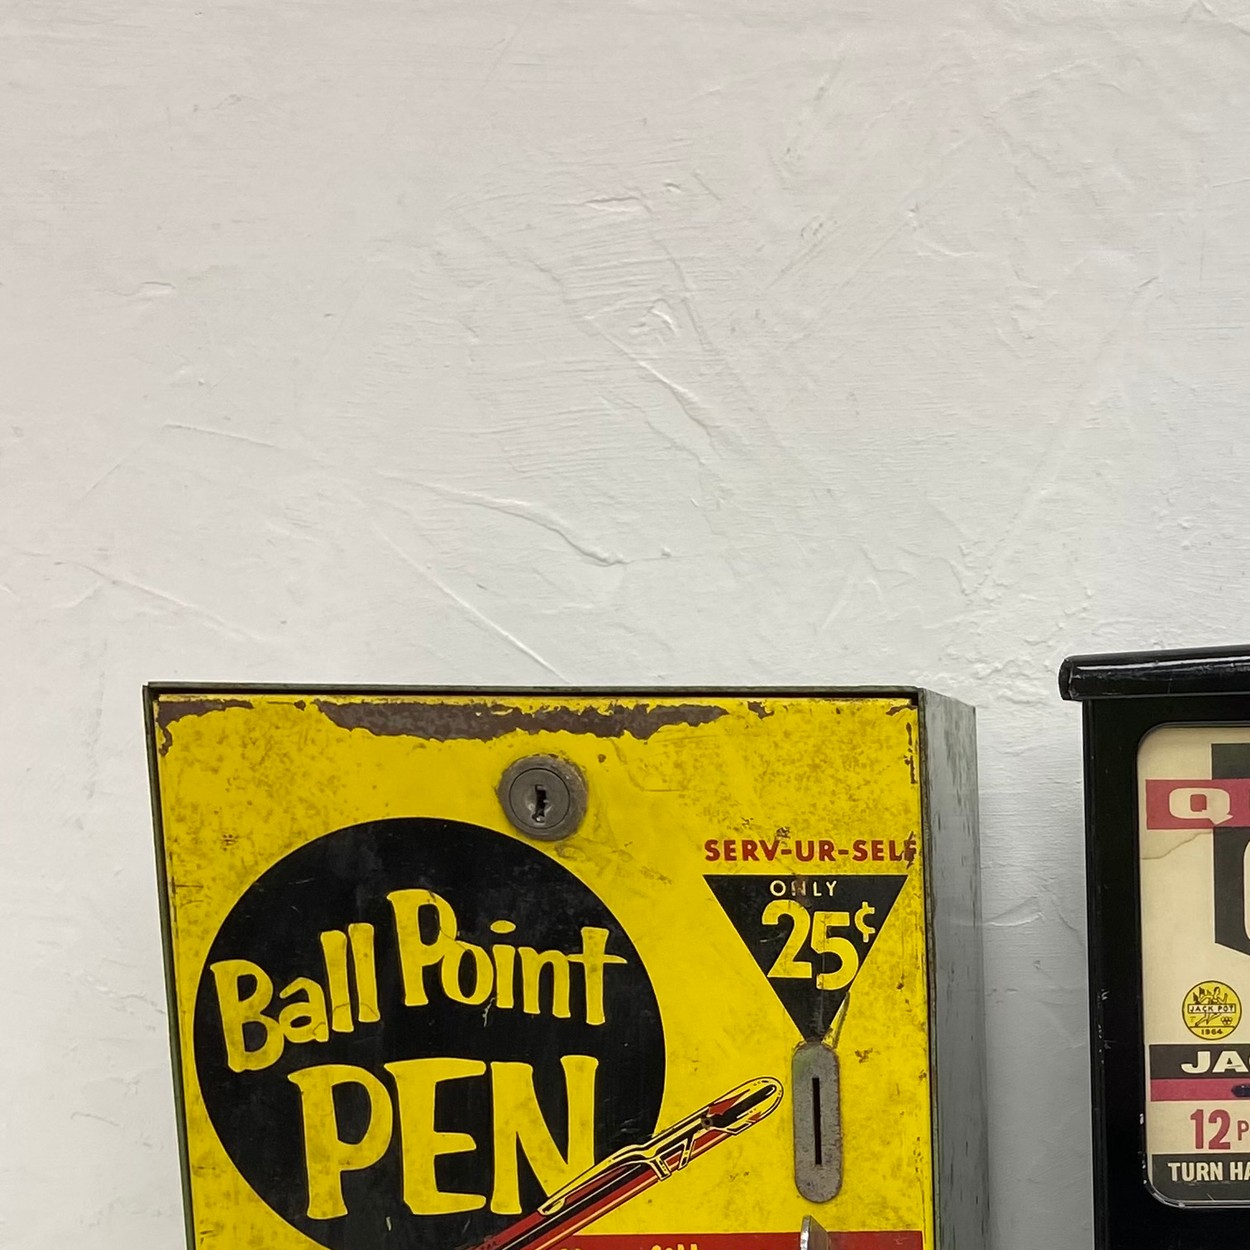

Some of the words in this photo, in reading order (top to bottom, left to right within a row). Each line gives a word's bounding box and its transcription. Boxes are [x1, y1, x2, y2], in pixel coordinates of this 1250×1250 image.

[769, 879, 838, 897] ONLY
[209, 922, 381, 1073] Ball
[387, 887, 629, 1026] Point
[1201, 1028, 1223, 1036] 1964
[287, 1054, 600, 1220] PEN
[1190, 1108, 1231, 1150] 12
[1168, 1161, 1223, 1182] TURN
